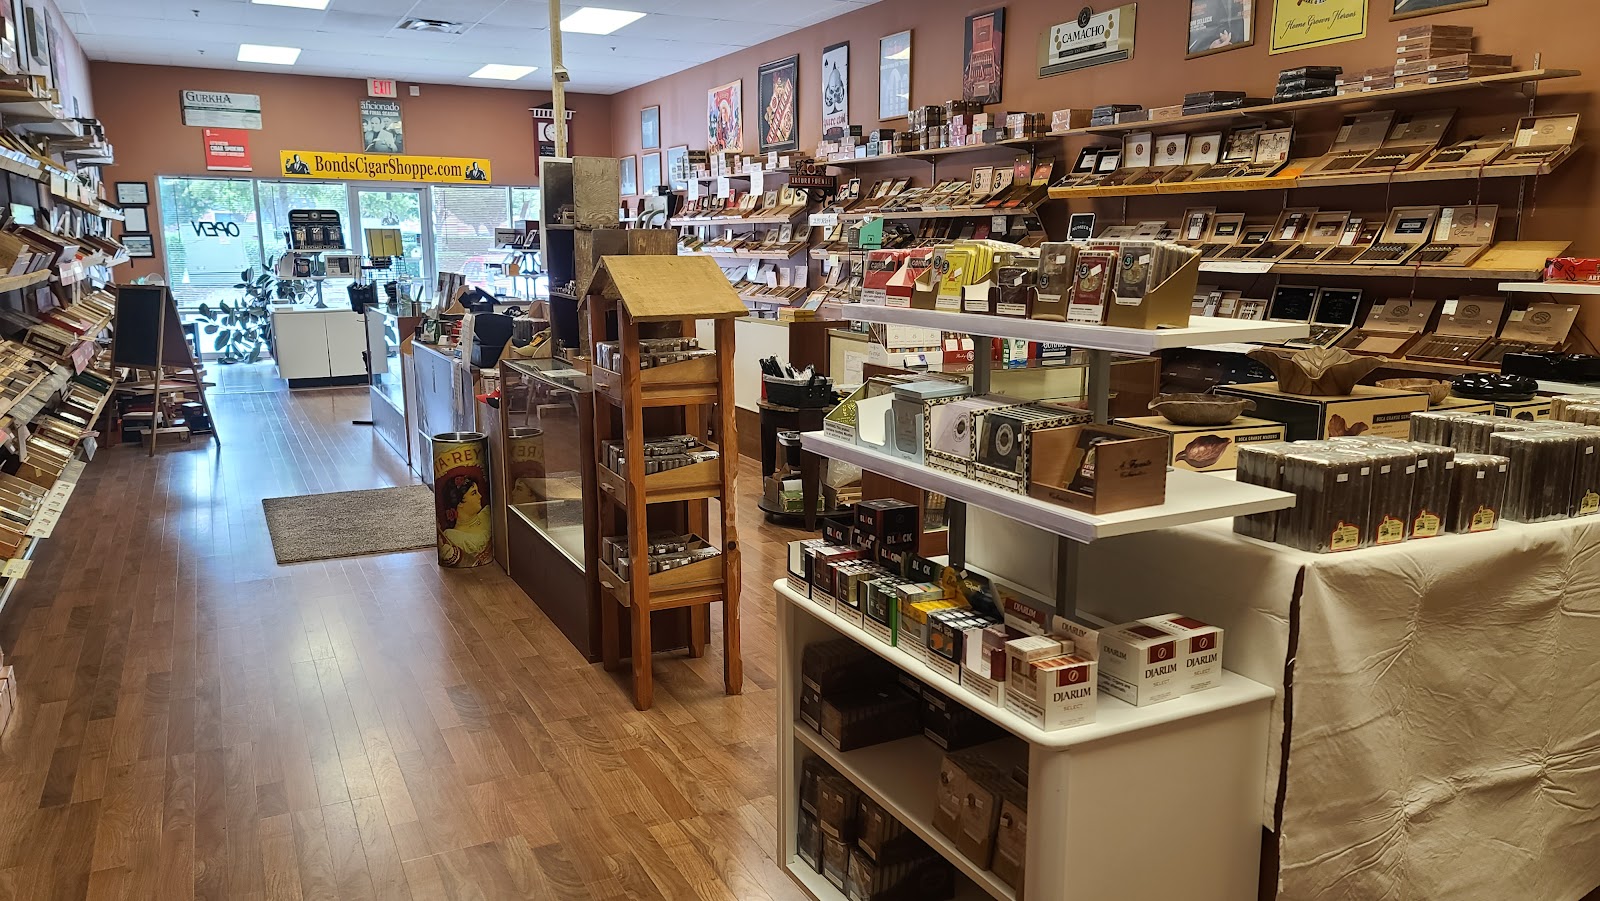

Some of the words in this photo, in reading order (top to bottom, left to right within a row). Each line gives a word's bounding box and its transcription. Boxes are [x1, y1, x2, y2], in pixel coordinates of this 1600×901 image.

[1062, 25, 1104, 43] CAMACHO
[1280, 19, 1306, 39] Home
[1305, 15, 1330, 34] Grown
[373, 80, 392, 95] EXIT
[186, 91, 232, 104] GURKHA
[361, 101, 399, 111] aficionado
[314, 155, 462, 180] BondsCigarShoppe.com
[860, 514, 873, 525] BLACK
[826, 526, 843, 540] BLACK
[887, 533, 913, 544] BLACK
[857, 536, 872, 549] BLACK
[912, 560, 931, 576] BLCK
[1013, 602, 1036, 618] DJARUM
[1061, 623, 1087, 637] DJARUM
[1103, 645, 1127, 660] DJARUM
[1186, 653, 1217, 668] DJARUM
[1145, 663, 1177, 679] DJARUM
[1194, 668, 1211, 676] SELECT
[1153, 679, 1170, 687] SELECT
[1053, 687, 1091, 702] DJARUM
